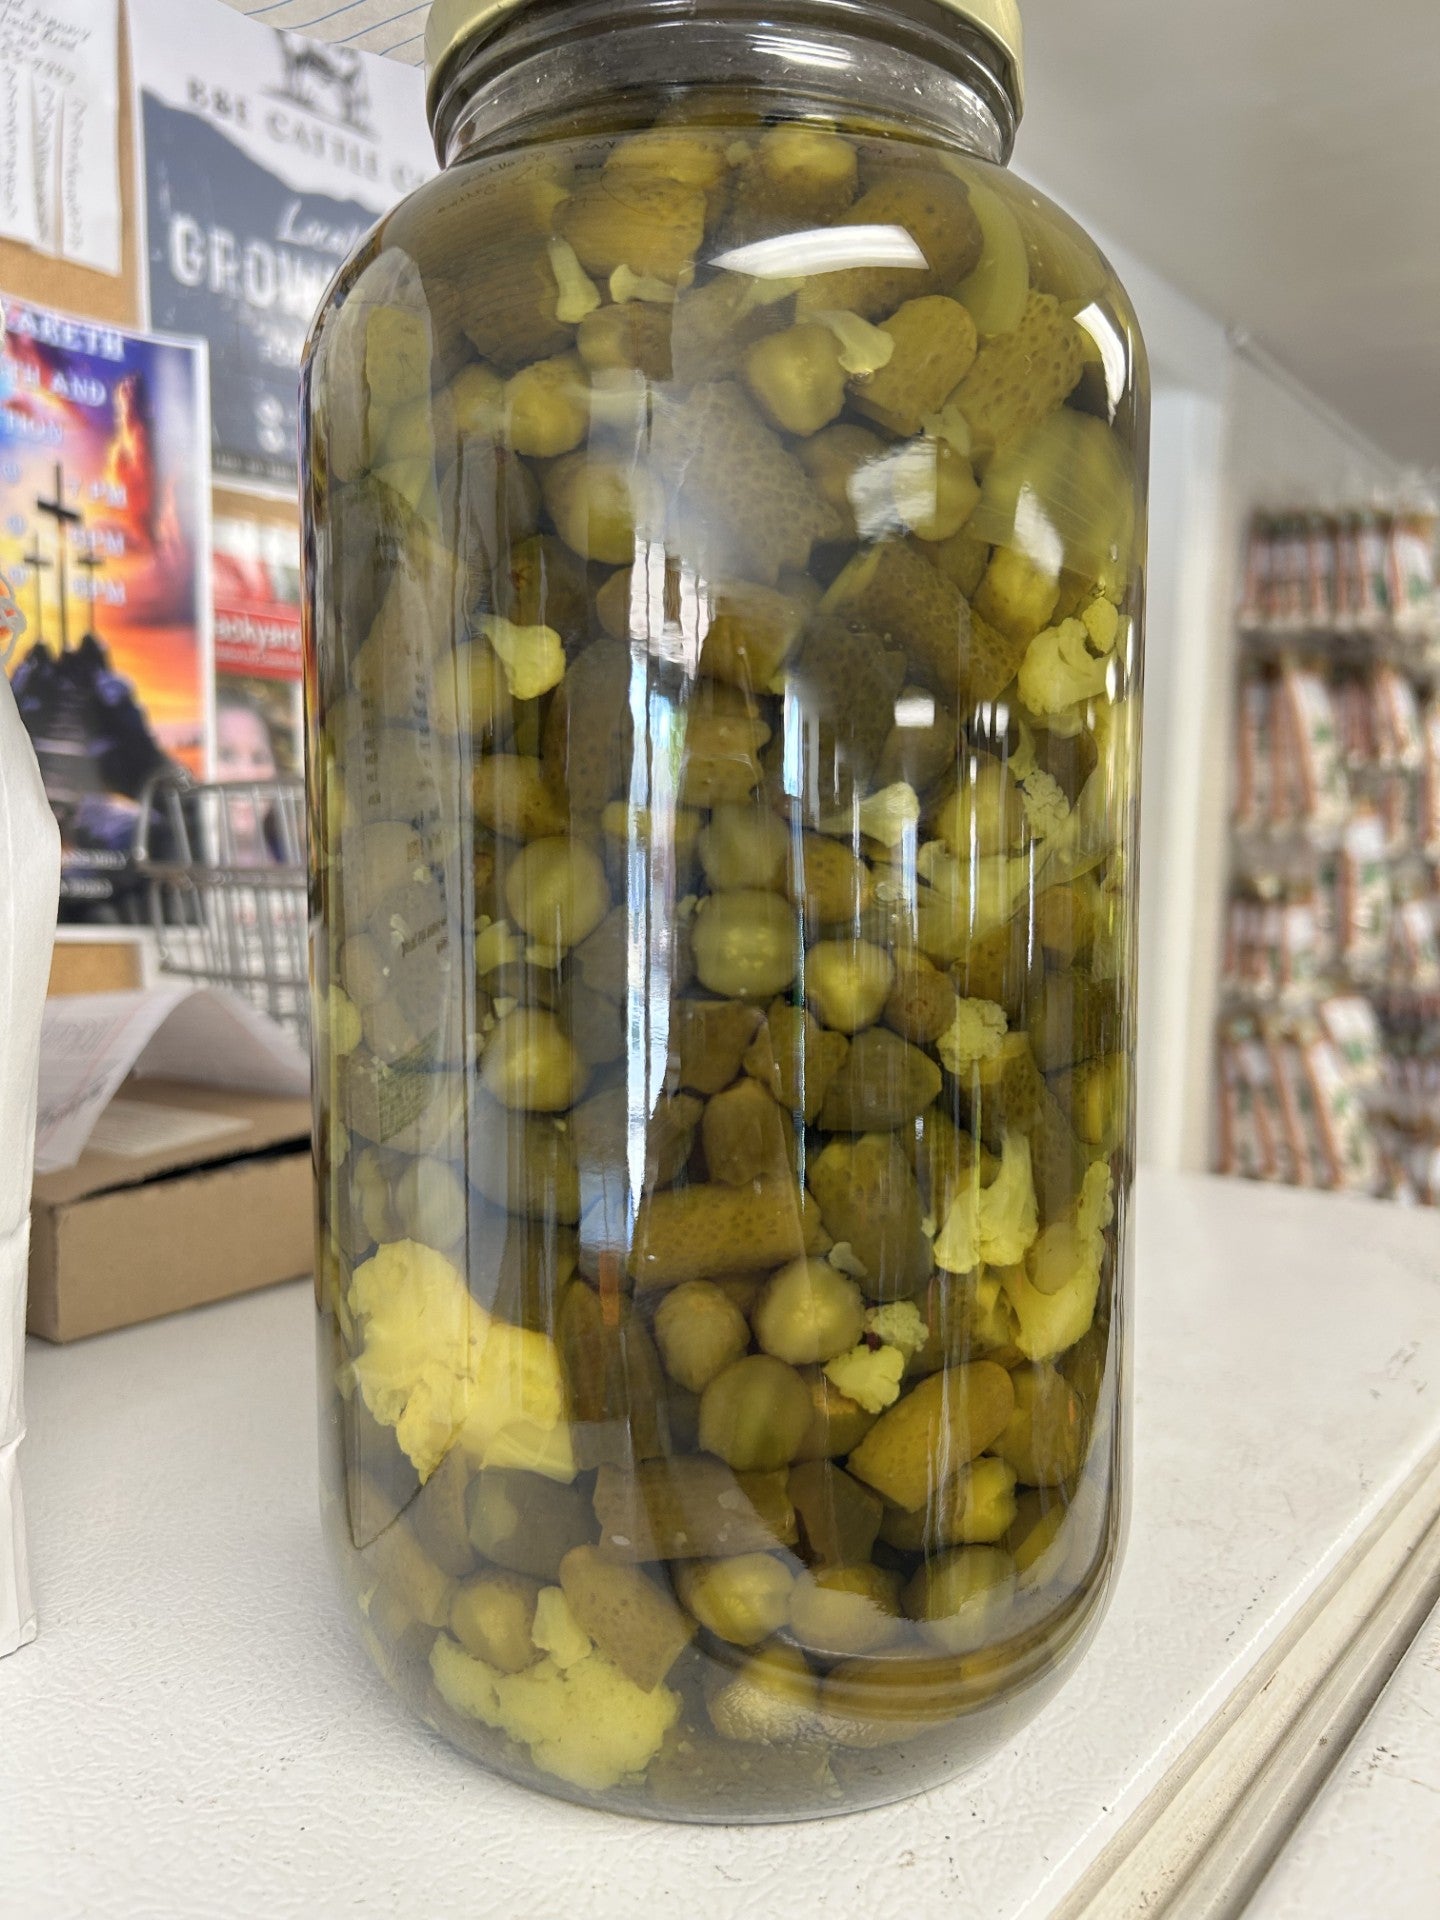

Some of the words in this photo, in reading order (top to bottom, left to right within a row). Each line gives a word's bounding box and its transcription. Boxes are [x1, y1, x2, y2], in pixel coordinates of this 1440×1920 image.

[267, 112, 378, 180] CATTLE
[18, 308, 124, 363] ARETH
[52, 371, 107, 407] AND
